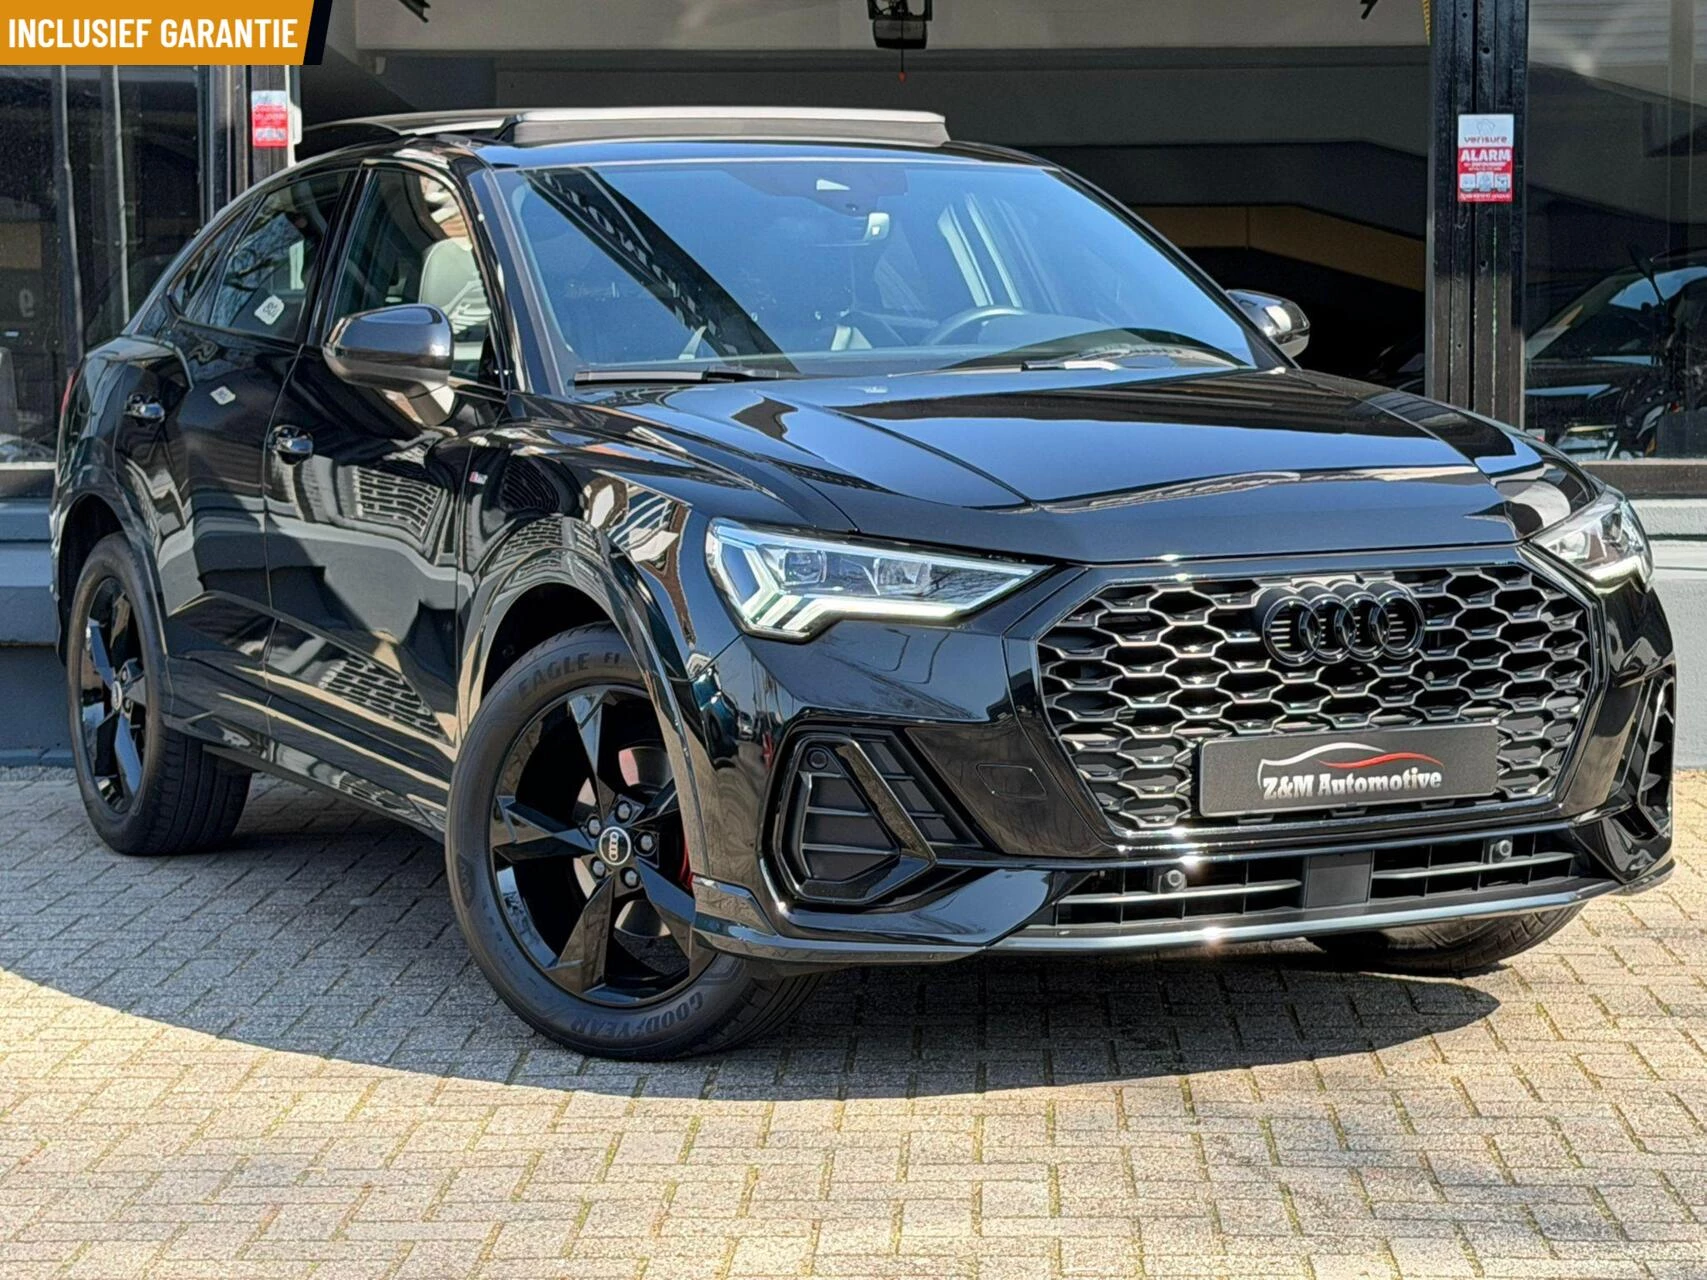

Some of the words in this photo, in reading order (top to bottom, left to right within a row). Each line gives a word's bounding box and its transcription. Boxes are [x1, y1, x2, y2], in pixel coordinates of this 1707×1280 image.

[1460, 148, 1512, 163] ALARM
[1463, 135, 1508, 144] verisure
[517, 652, 591, 699] EAGLE
[1262, 773, 1314, 800] Z&M
[1317, 767, 1442, 797] Automotive
[570, 991, 705, 1039] GOODYEAR
